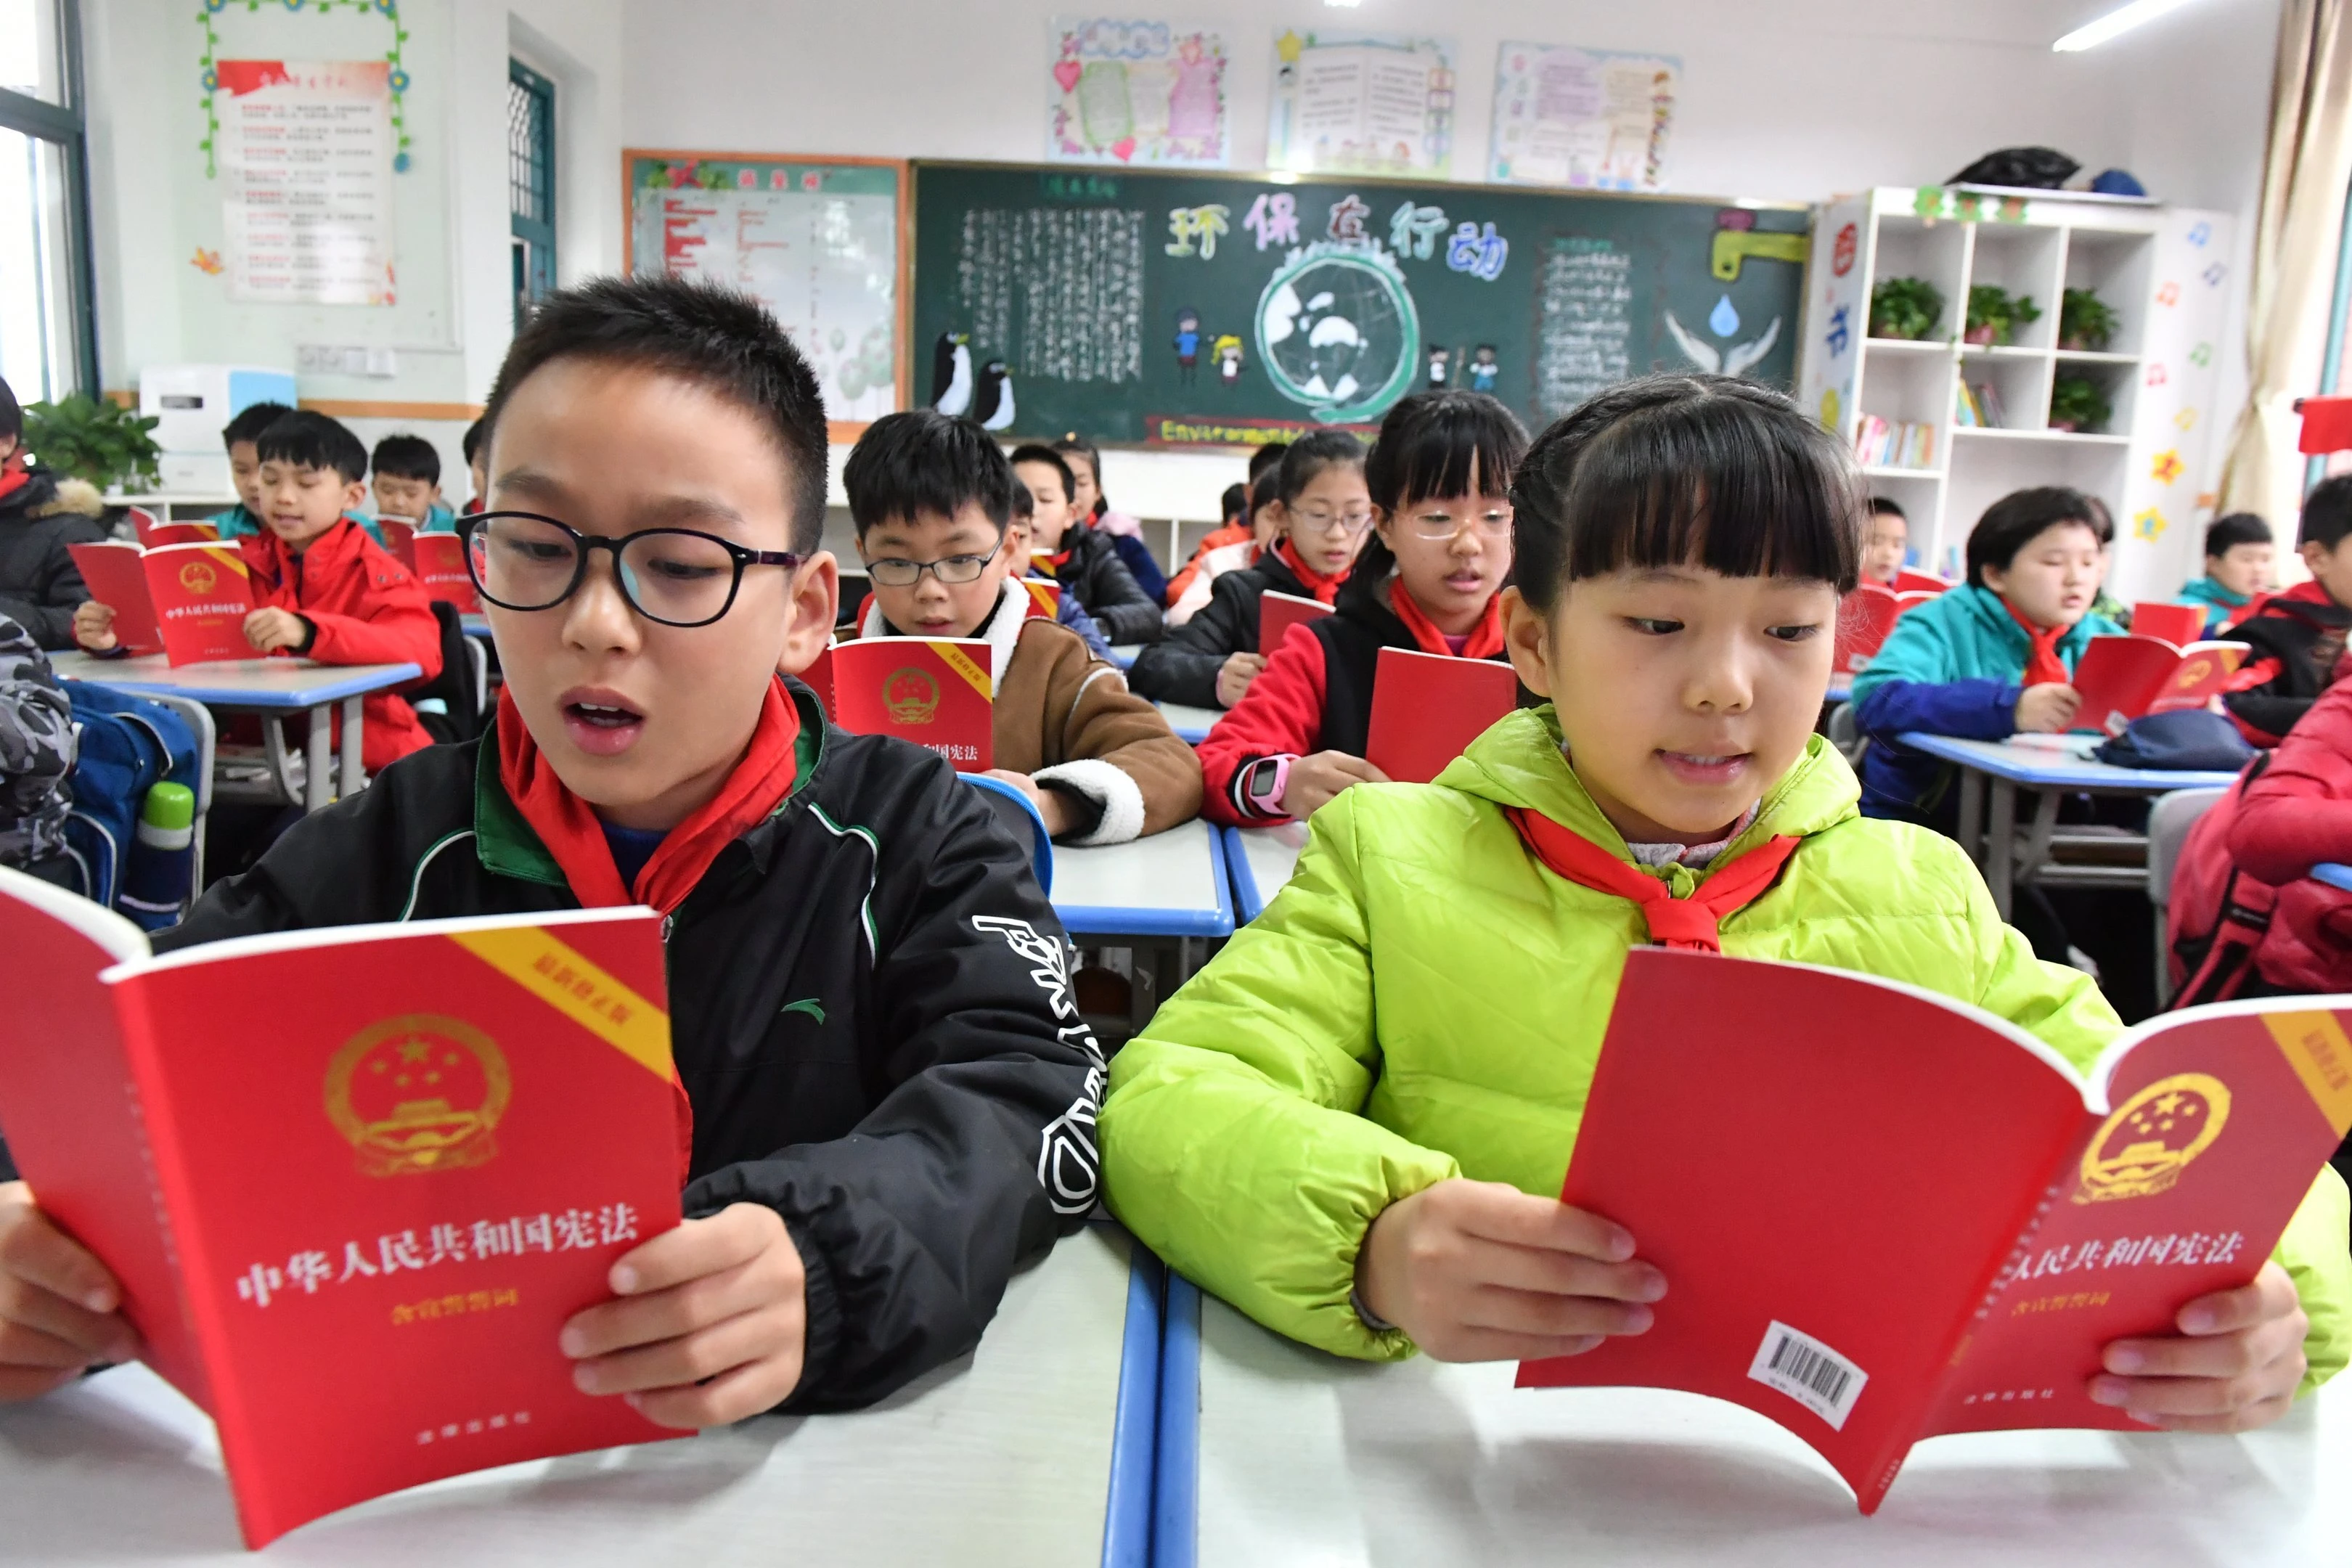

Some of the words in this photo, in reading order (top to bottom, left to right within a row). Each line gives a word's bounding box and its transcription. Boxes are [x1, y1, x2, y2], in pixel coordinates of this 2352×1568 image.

[1164, 192, 1509, 282] 环保在行动
[1161, 419, 1306, 446] Environmentl
[236, 1201, 640, 1308] 中华人民共和国宪法
